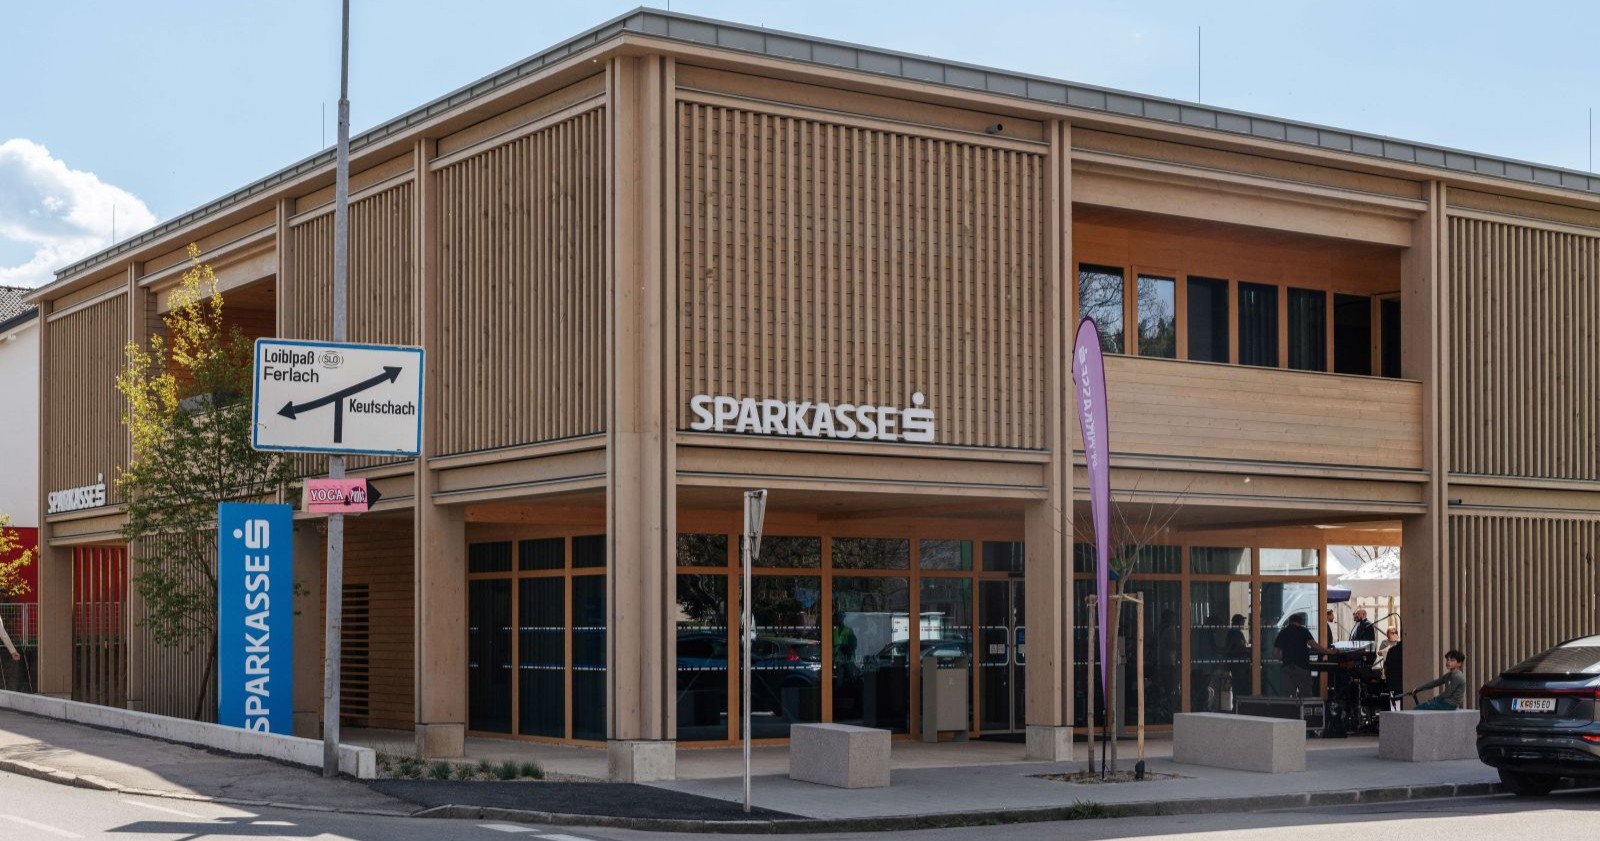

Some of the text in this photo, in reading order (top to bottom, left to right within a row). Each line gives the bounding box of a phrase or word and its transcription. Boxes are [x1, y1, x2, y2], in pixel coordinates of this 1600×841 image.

[264, 348, 339, 368] Loiblpaß SLO
[263, 366, 319, 383] Ferlach
[349, 399, 415, 416] Keutschach
[690, 394, 898, 441] SPARKASSE
[48, 485, 96, 514] SPARKASSE
[310, 488, 344, 501] YOGA
